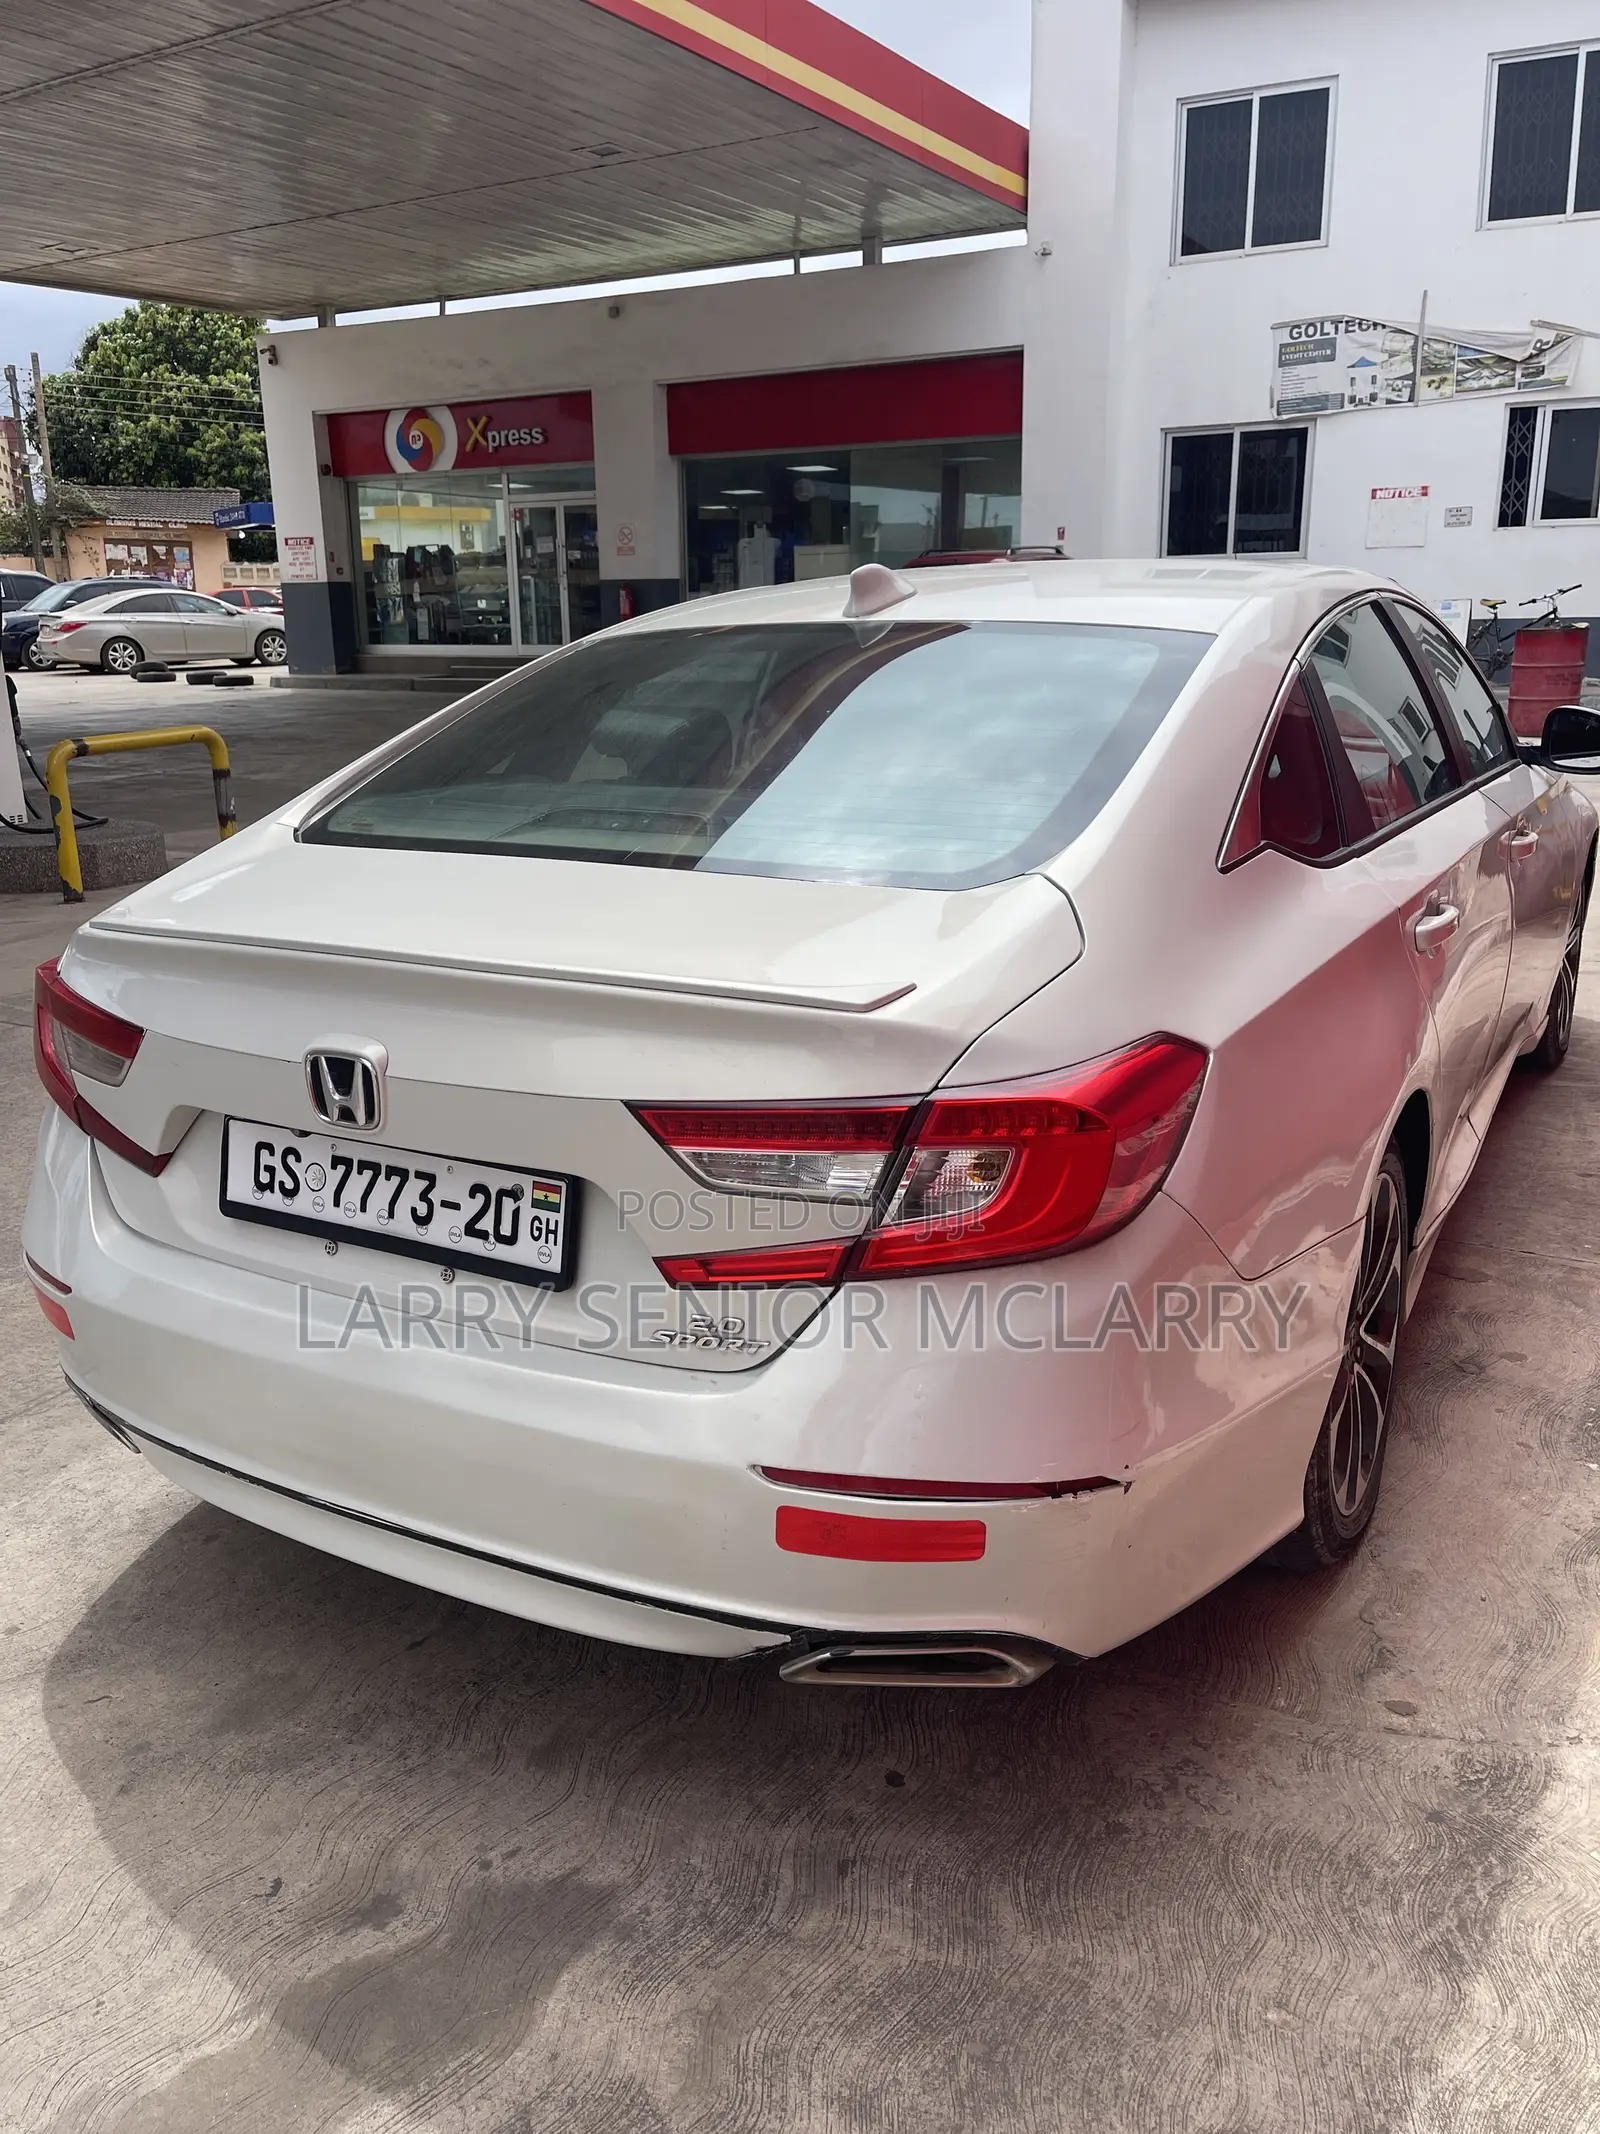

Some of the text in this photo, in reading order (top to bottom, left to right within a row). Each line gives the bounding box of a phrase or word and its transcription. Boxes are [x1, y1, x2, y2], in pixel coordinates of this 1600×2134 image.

[465, 415, 544, 453] Xpress
[1376, 487, 1422, 499] NOTICE
[253, 1141, 301, 1198] GS
[530, 1215, 559, 1246] GH
[688, 1313, 745, 1334] 2.0
[649, 1329, 771, 1355] SPORT
